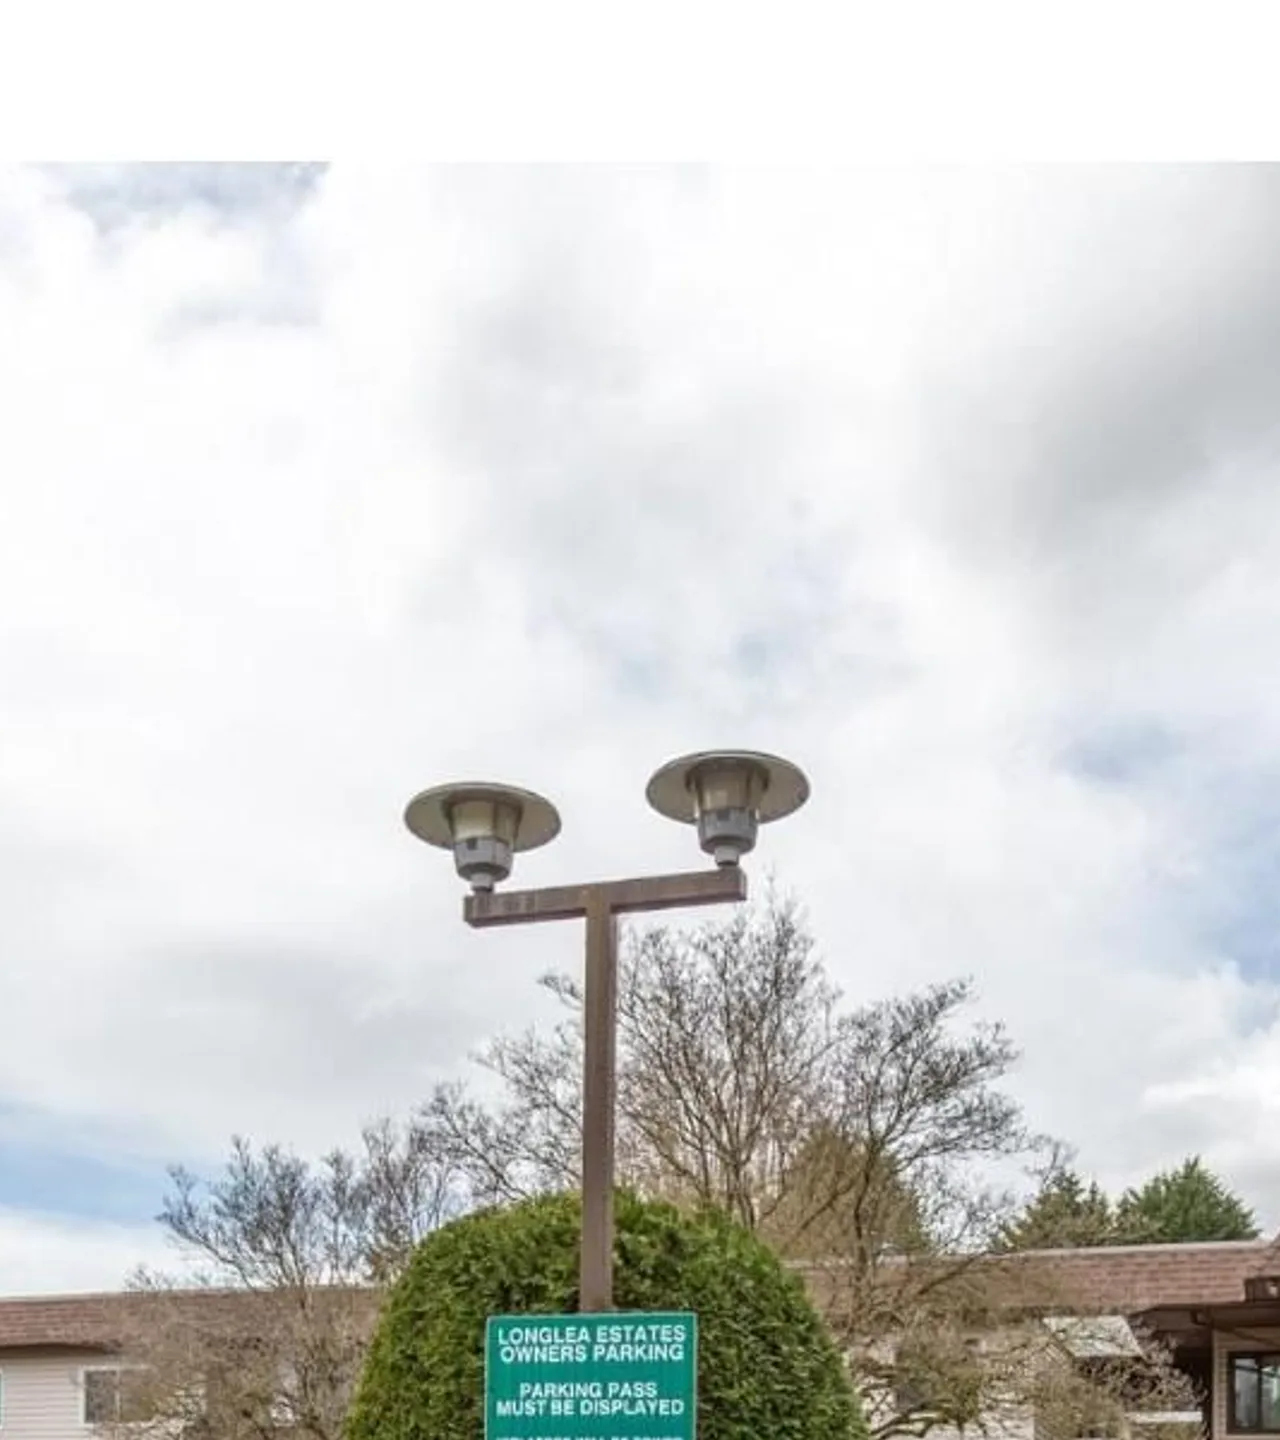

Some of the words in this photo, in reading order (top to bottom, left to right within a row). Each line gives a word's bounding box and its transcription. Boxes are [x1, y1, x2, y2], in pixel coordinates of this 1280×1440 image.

[498, 1326, 591, 1345] LONGLEA
[596, 1324, 686, 1342] ESTATES
[500, 1346, 587, 1363] OWNERS
[594, 1344, 684, 1361] PARKING
[520, 1382, 602, 1398] PARKING
[608, 1382, 658, 1398] PASS
[496, 1400, 546, 1416] MUST
[550, 1400, 574, 1415] BE
[580, 1399, 684, 1415] DISPLAYED
